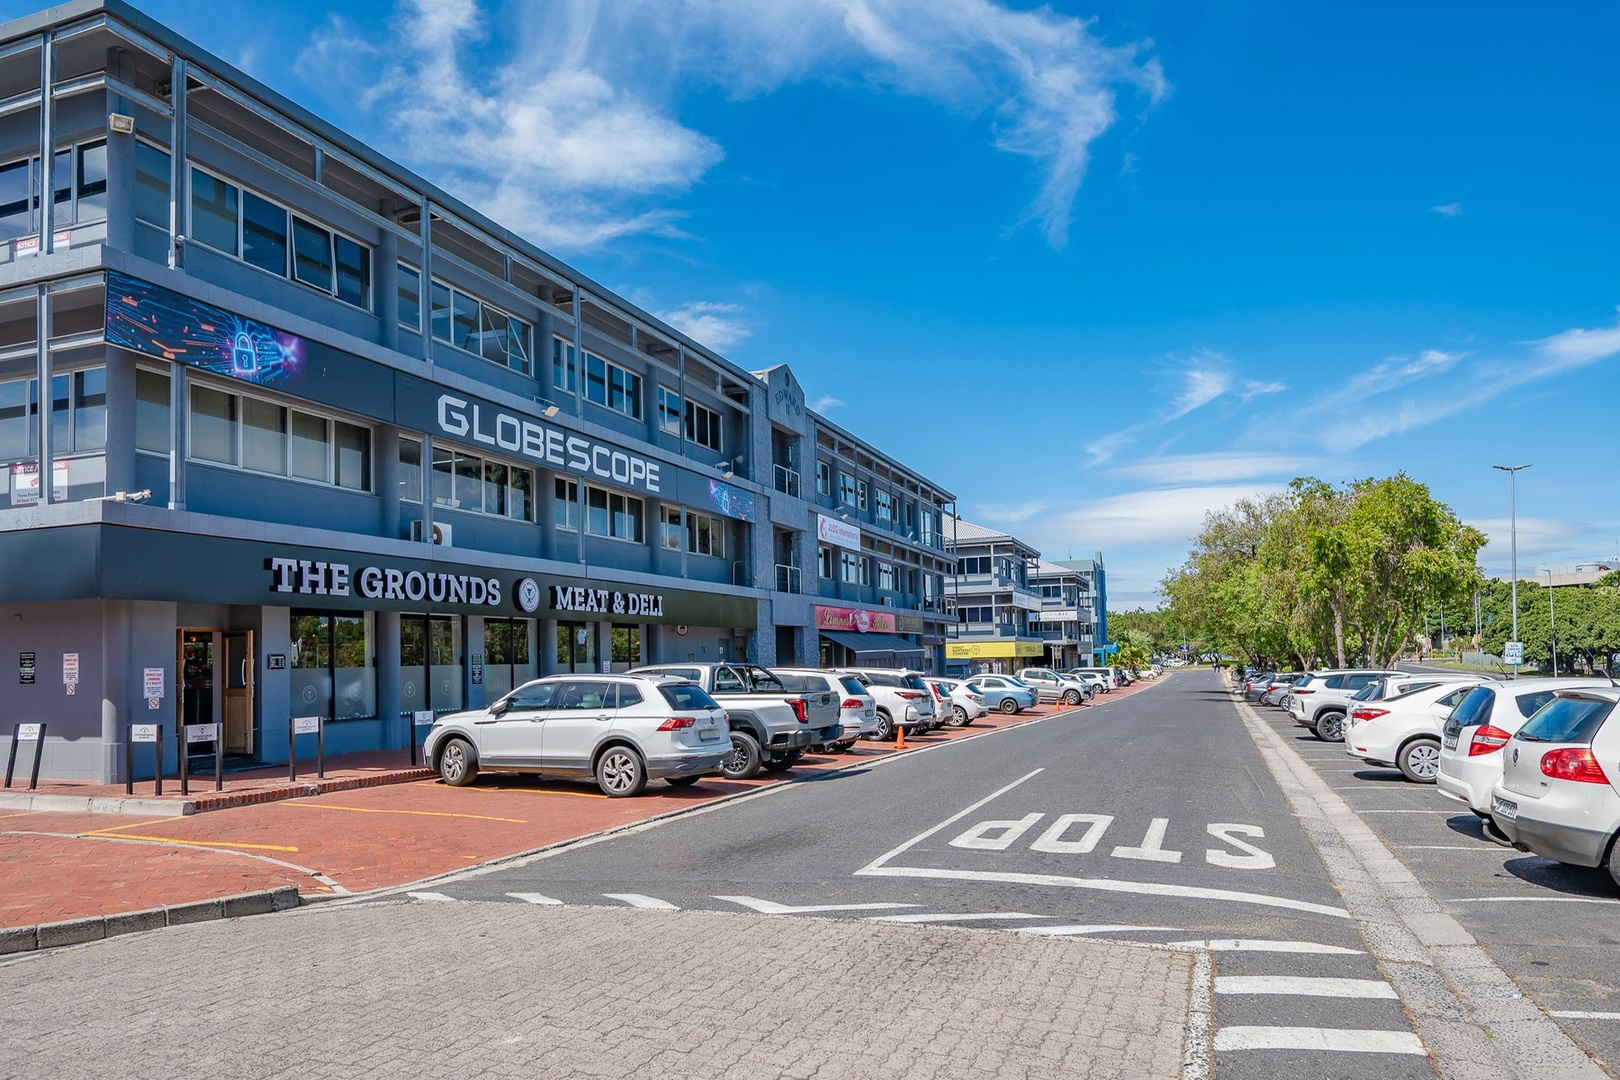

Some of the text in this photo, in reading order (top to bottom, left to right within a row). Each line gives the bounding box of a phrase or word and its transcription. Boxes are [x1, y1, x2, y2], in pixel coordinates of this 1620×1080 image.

[17, 241, 36, 250] NOTICE
[774, 388, 801, 416] EDWARD
[437, 394, 660, 493] GLOBESCOPE
[13, 465, 34, 474] NOTICE
[271, 557, 663, 617] THE GROUNDS MEAT & DELI
[948, 812, 1276, 870] STOP
